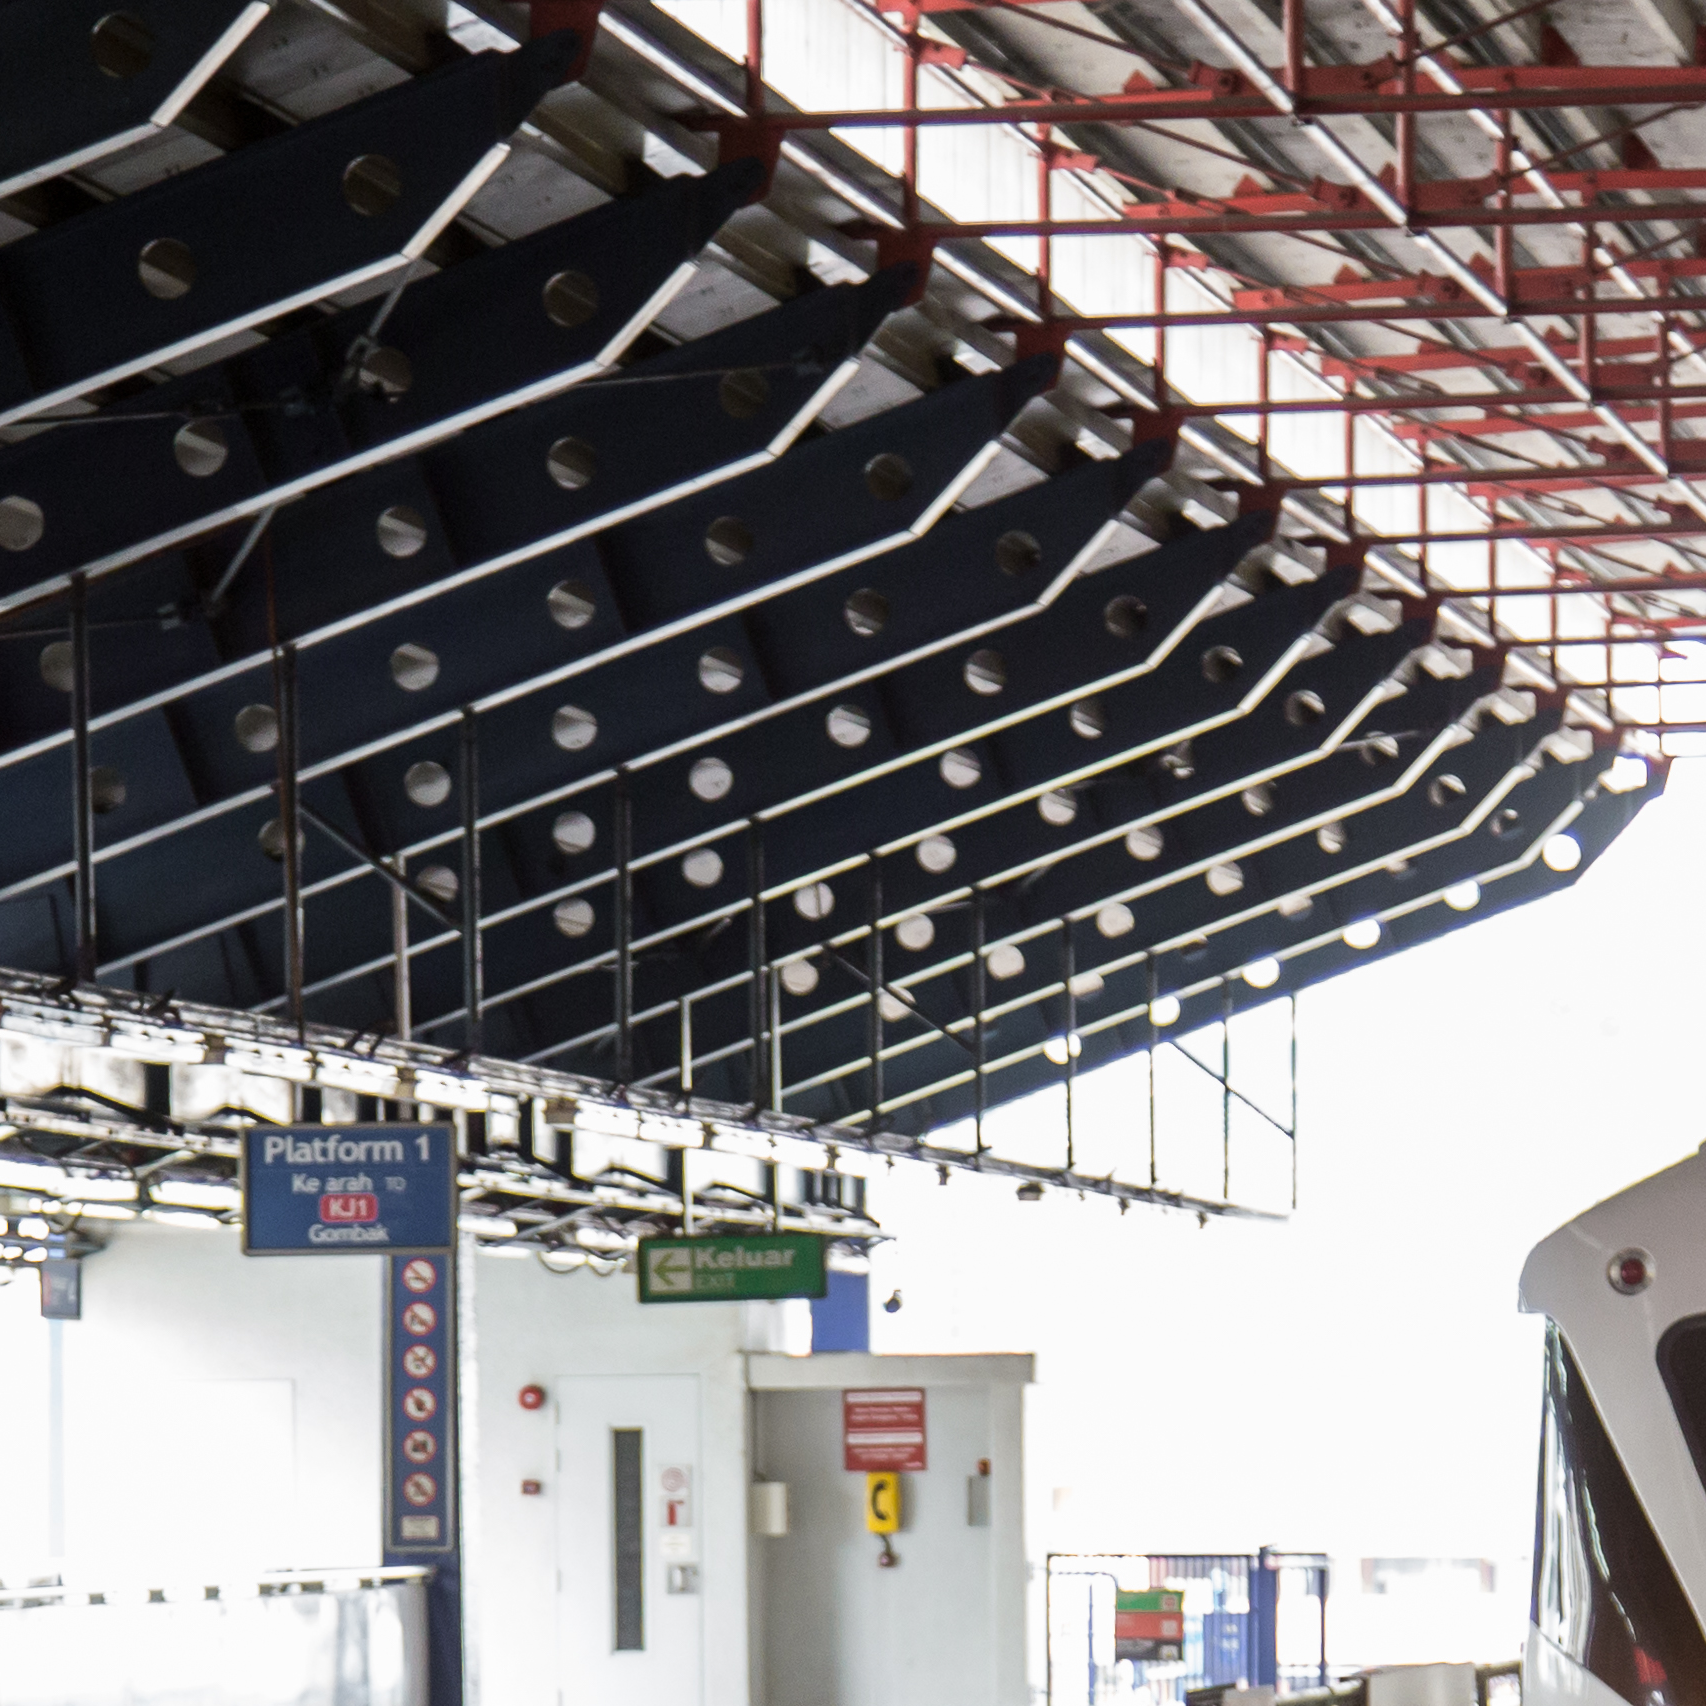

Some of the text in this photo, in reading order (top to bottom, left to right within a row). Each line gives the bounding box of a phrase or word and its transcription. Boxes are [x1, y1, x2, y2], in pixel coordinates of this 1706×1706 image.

[263, 1133, 431, 1165] Platform 1
[291, 1172, 407, 1194] Ke arah TO
[328, 1197, 369, 1217] KJ1
[307, 1222, 391, 1244] Gombak
[694, 1246, 795, 1270] Keluar
